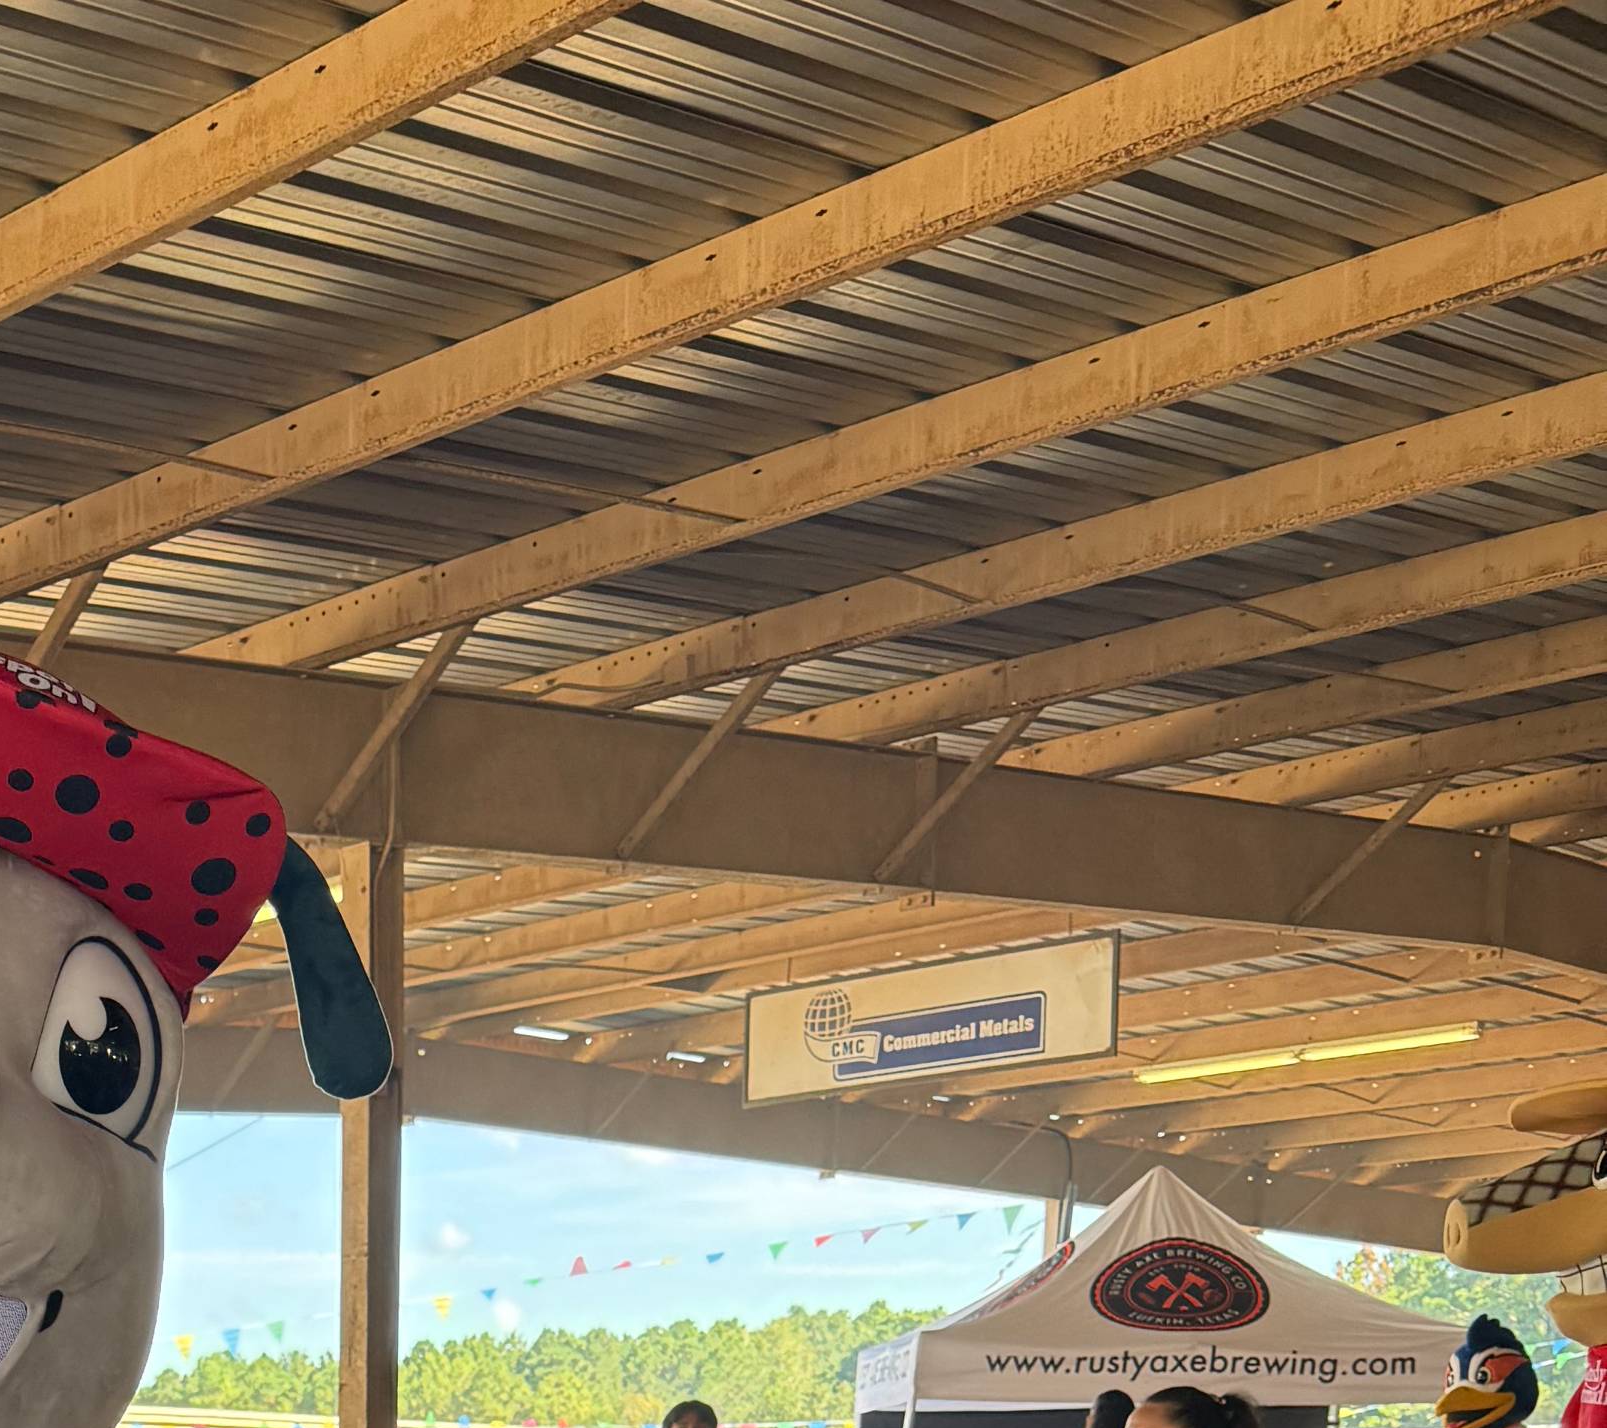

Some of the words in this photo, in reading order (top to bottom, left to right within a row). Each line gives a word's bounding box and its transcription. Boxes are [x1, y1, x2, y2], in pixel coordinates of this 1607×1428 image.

[831, 1038, 865, 1058] CMC
[883, 1022, 977, 1053] Commercial
[979, 1014, 1035, 1038] Metals
[1166, 1248, 1231, 1276] BREWING
[1230, 1274, 1248, 1290] CO
[1197, 1308, 1240, 1326] TEXAS
[985, 1345, 1417, 1383] www.rustyaxebrewing.com
